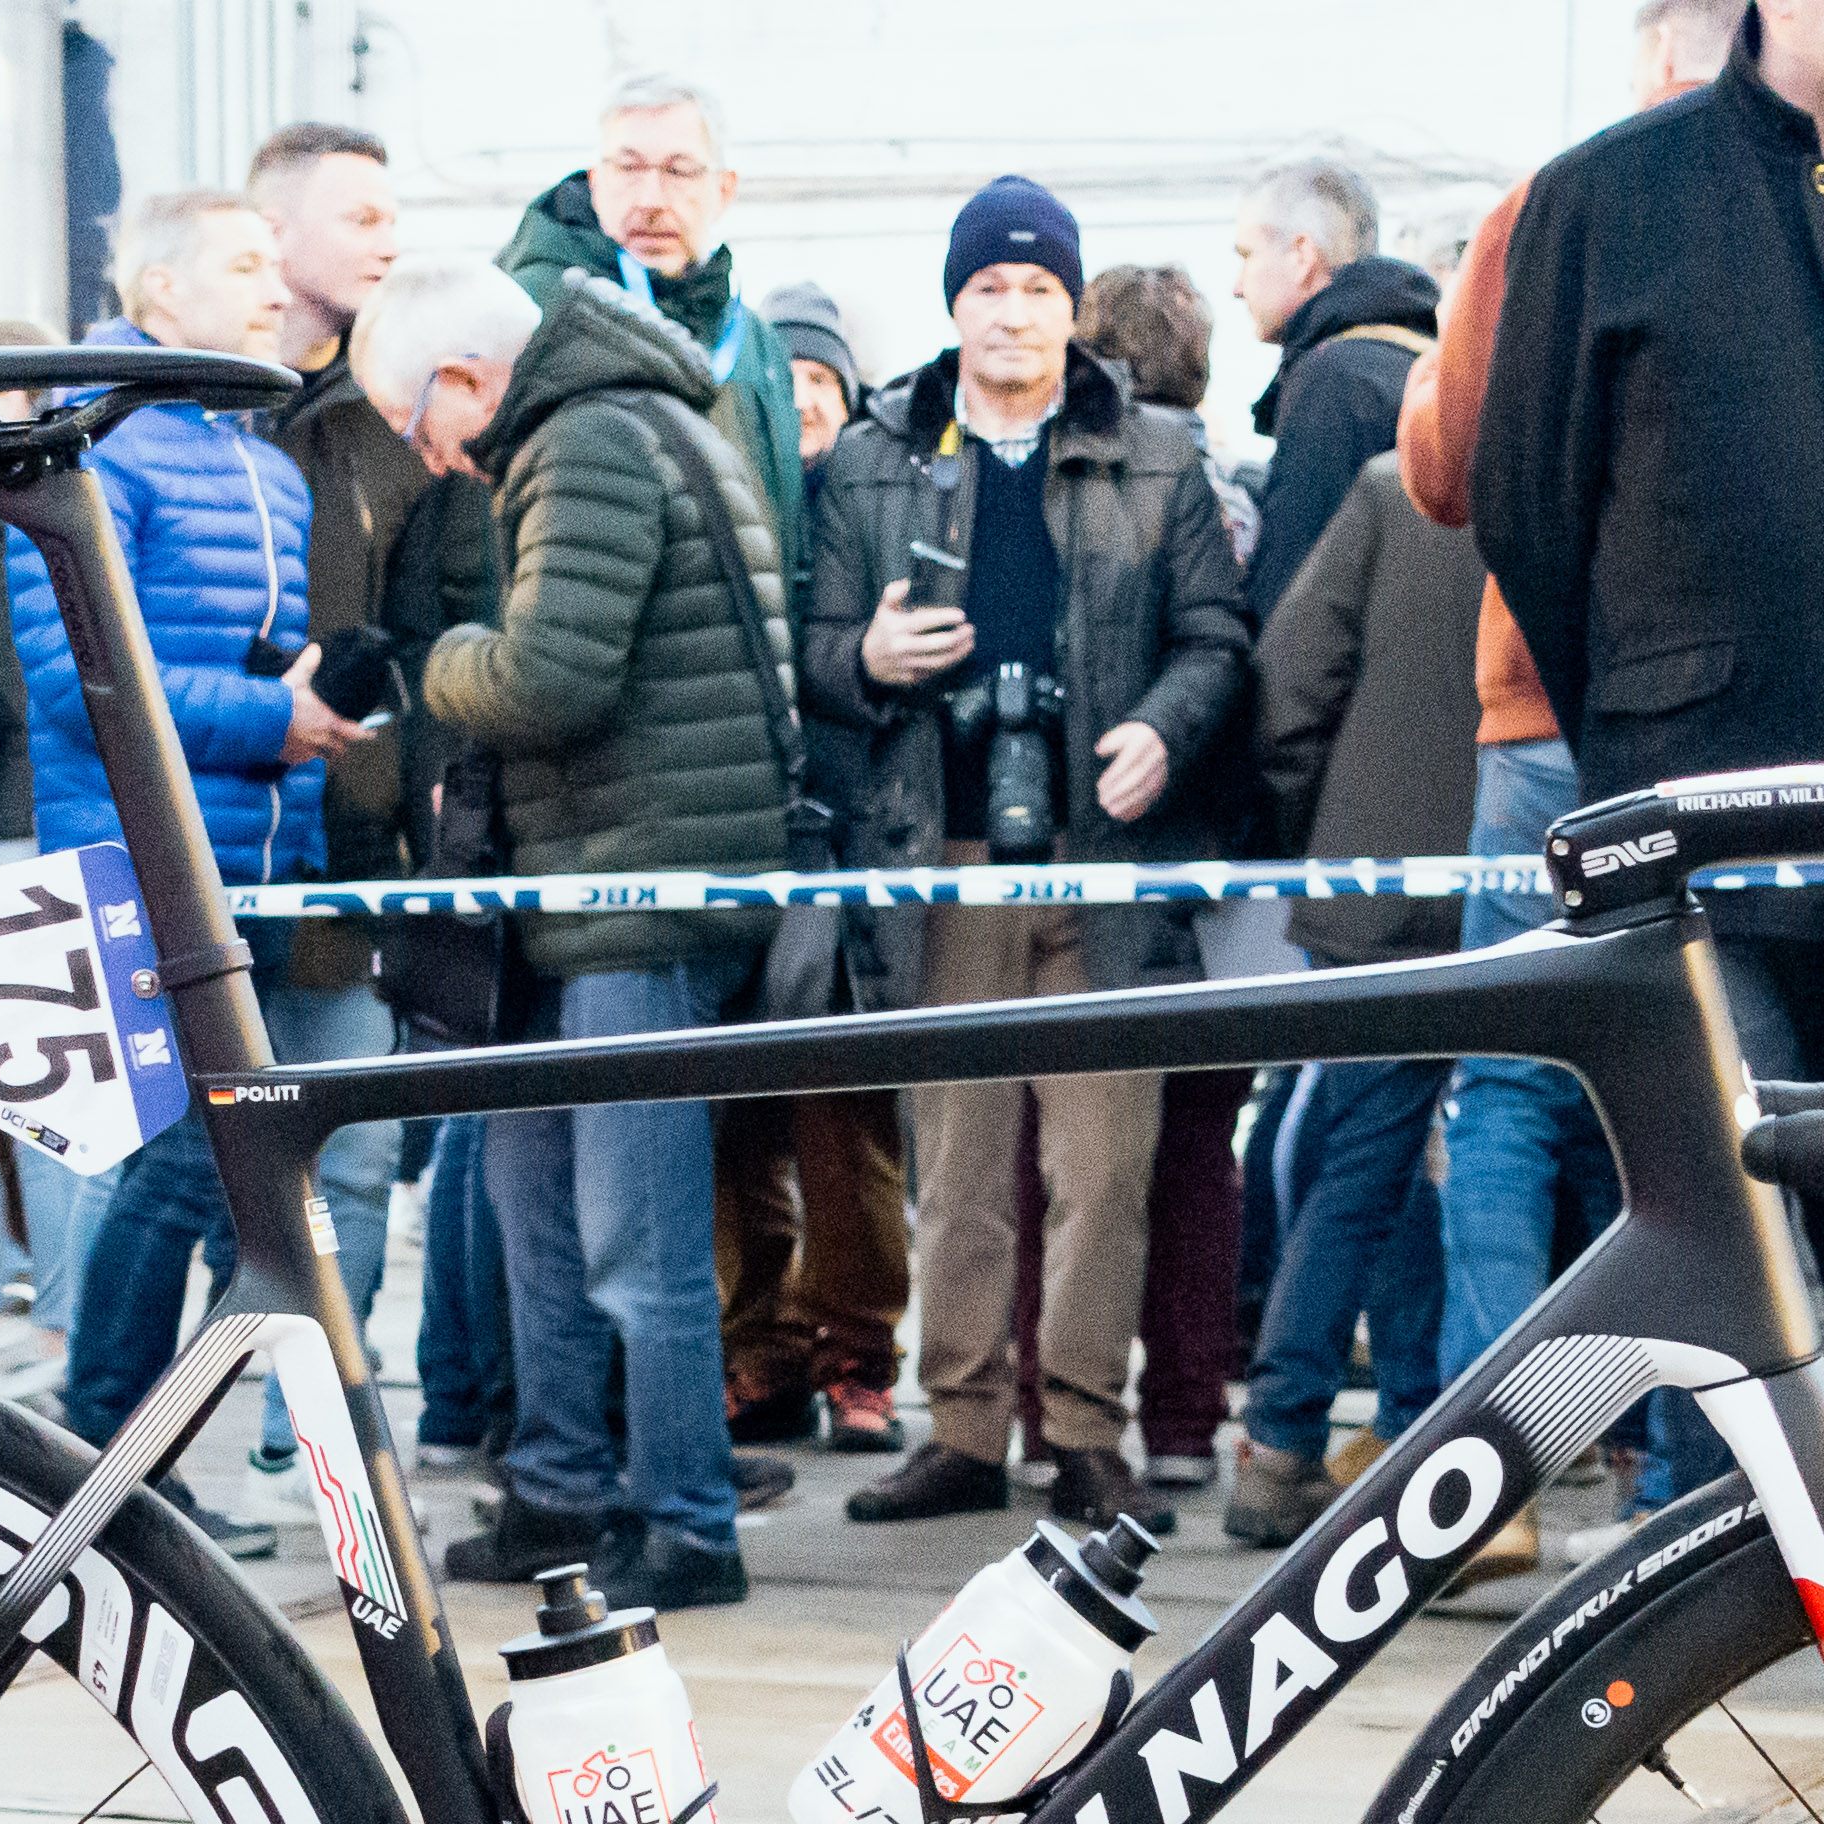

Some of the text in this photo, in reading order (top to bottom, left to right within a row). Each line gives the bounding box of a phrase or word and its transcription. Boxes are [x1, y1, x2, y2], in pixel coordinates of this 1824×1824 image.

[1676, 790, 1773, 812] RICHARD
[234, 1084, 301, 1103] POLITT
[0, 1106, 27, 1129] UCI
[351, 1594, 404, 1641] UAE
[1450, 1636, 1552, 1759] GRAND
[1550, 1569, 1638, 1650] PRIX
[1636, 1506, 1745, 1584] 5000
[923, 1668, 1010, 1756] UAE
